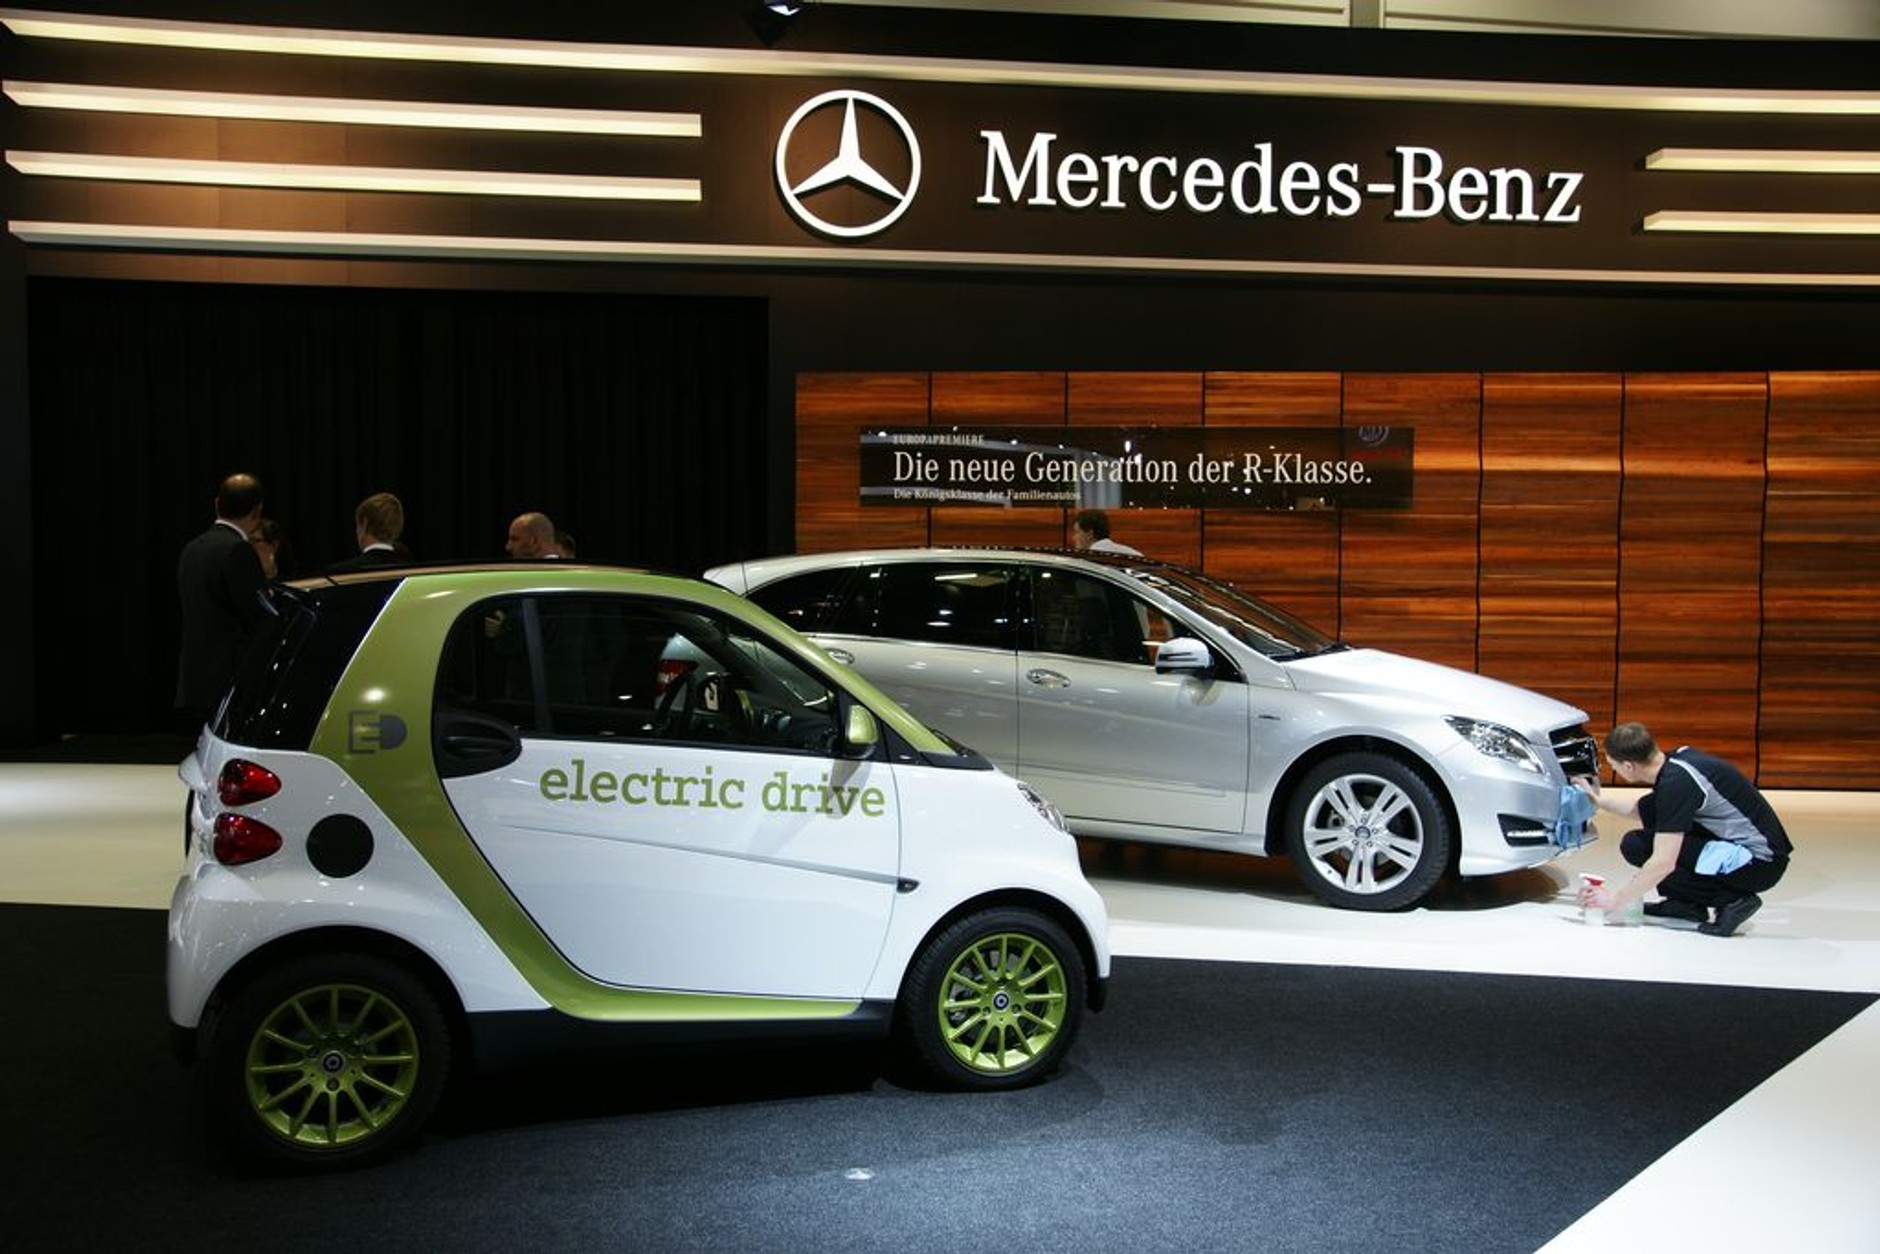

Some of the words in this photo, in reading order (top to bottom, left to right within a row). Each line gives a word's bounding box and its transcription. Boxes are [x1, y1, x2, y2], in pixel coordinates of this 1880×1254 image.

[976, 129, 1584, 223] Mercedes-Benz
[893, 434, 985, 445] EUROPAPREMIERE
[893, 451, 939, 482] Die
[949, 458, 1015, 483] neue
[1025, 451, 1178, 483] Generation
[1188, 452, 1235, 483] der
[1244, 453, 1372, 484] R-Klasse.
[893, 489, 912, 499] Die
[914, 489, 984, 501] Königsklasse
[986, 489, 1004, 499] der
[540, 759, 745, 809] electric
[762, 772, 884, 817] drive
